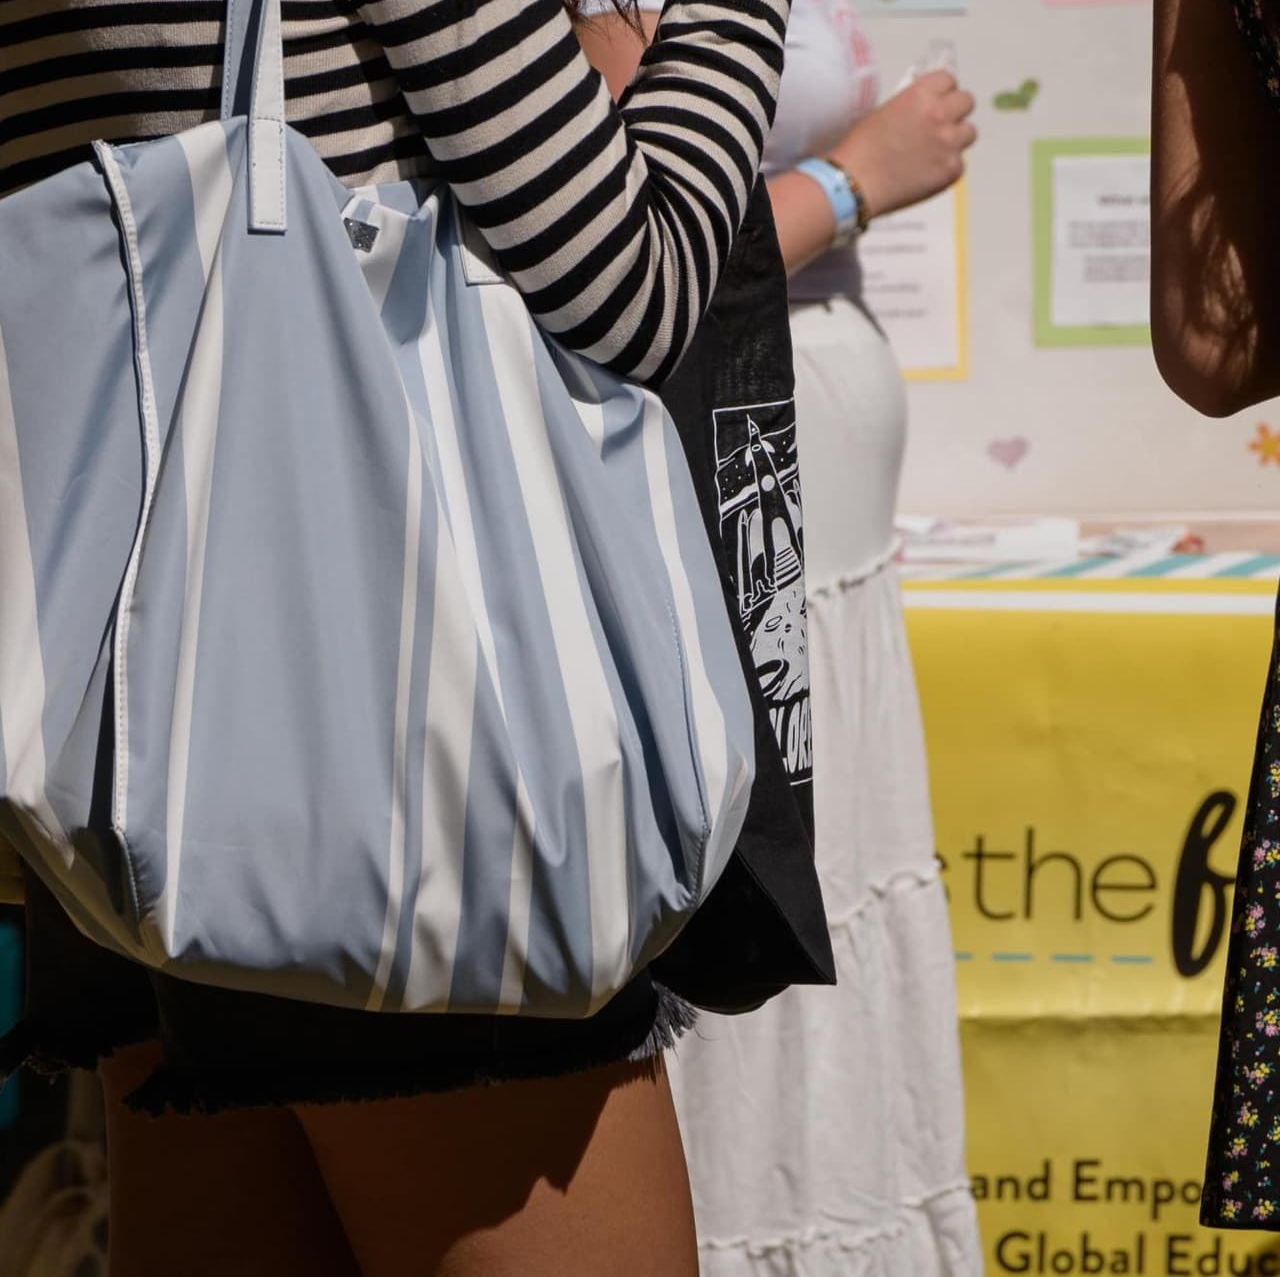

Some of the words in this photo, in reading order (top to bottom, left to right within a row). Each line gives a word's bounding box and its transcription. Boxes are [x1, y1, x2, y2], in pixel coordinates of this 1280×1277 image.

[963, 826, 1159, 925] the
[970, 1158, 1053, 1204] and
[994, 1231, 1146, 1277] Global
